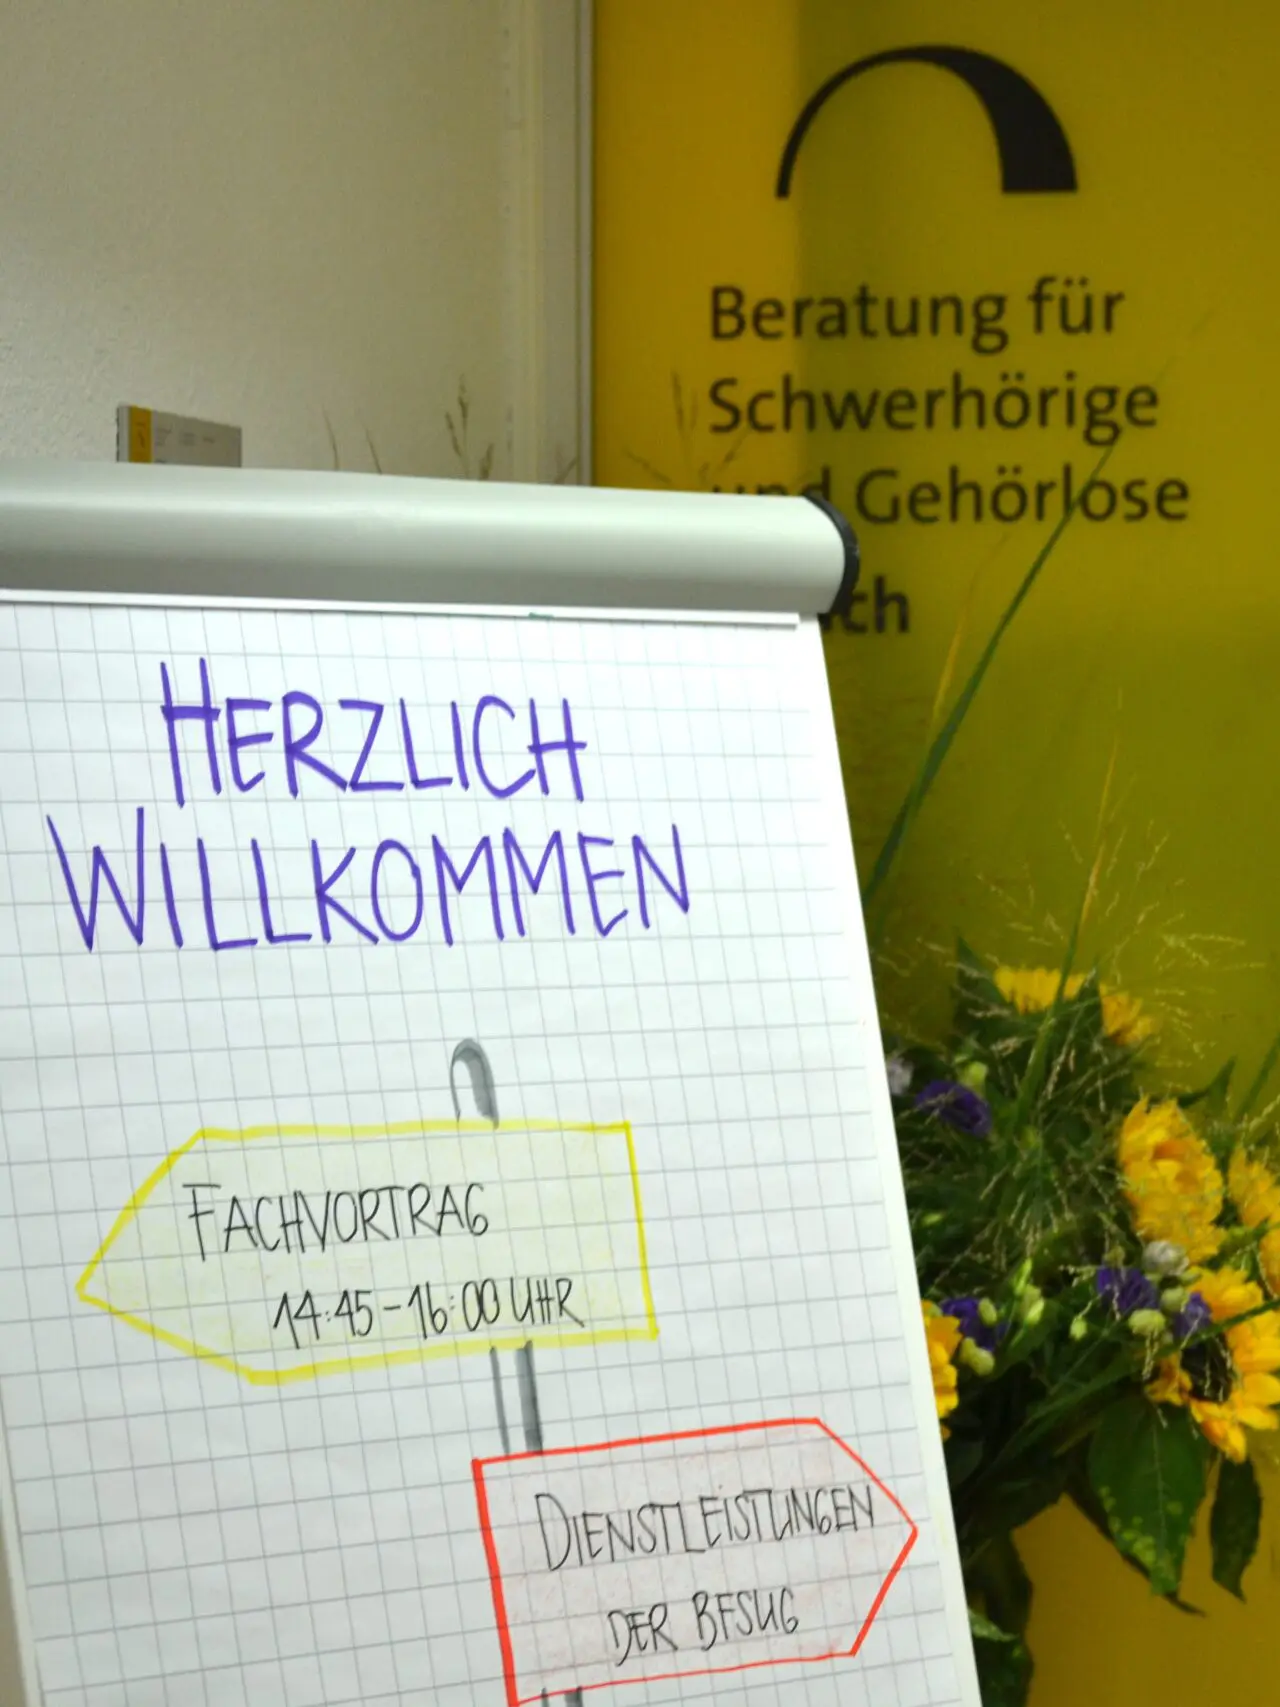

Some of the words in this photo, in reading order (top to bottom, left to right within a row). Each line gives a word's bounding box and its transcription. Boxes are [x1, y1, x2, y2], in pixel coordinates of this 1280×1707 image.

[710, 283, 1009, 355] Beratung
[1027, 275, 1126, 335] für
[708, 370, 1160, 446] Schwerhörige
[855, 463, 1191, 524] Gehörlose
[159, 656, 588, 808] HERZLICH
[46, 806, 691, 953] WILLKOMMEN
[182, 1183, 489, 1262] FACHVORTRAG
[509, 1276, 585, 1328] UHR
[534, 1484, 875, 1571] DIENSTLEISTUNGEN
[606, 1601, 679, 1667] DER
[691, 1586, 799, 1651] BFSUG
